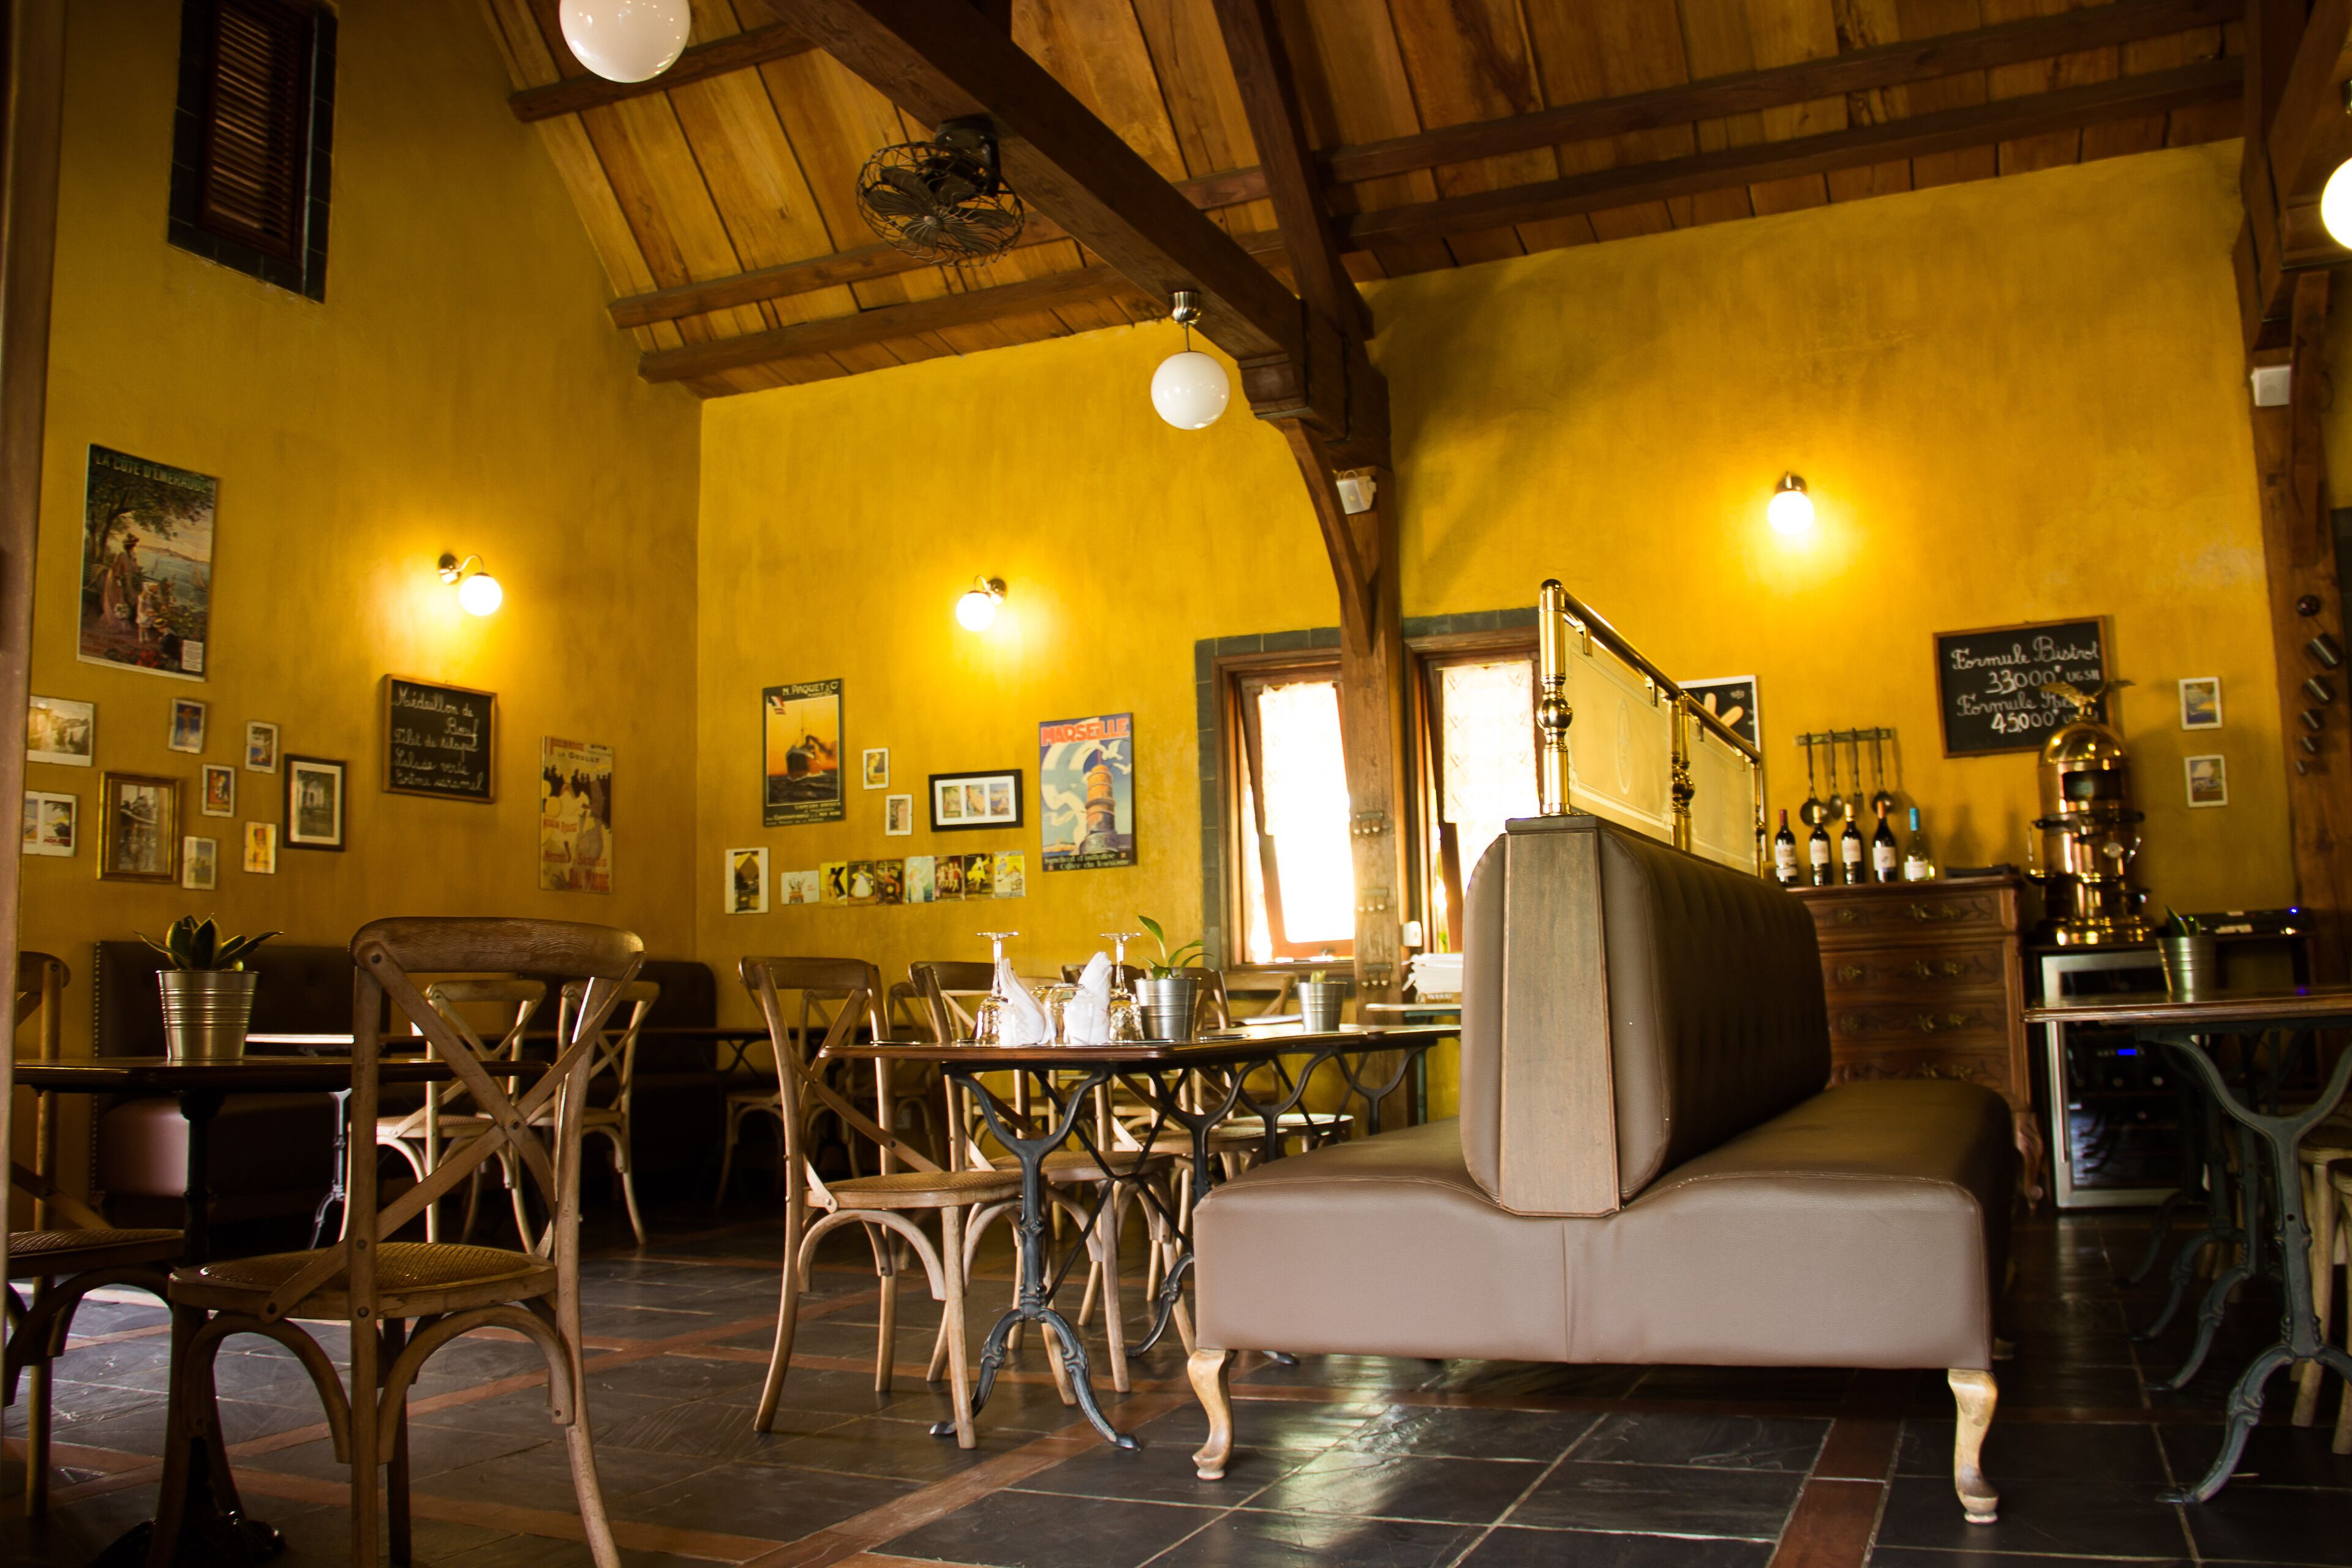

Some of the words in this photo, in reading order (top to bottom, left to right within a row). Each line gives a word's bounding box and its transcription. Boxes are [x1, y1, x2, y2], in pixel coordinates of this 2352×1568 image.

[1951, 644, 2031, 670] Formule
[2032, 635, 2100, 663] Bistrot
[791, 683, 825, 695] PAQUET
[1957, 691, 2038, 717] Formule
[1041, 717, 1129, 747] MARSEILLE
